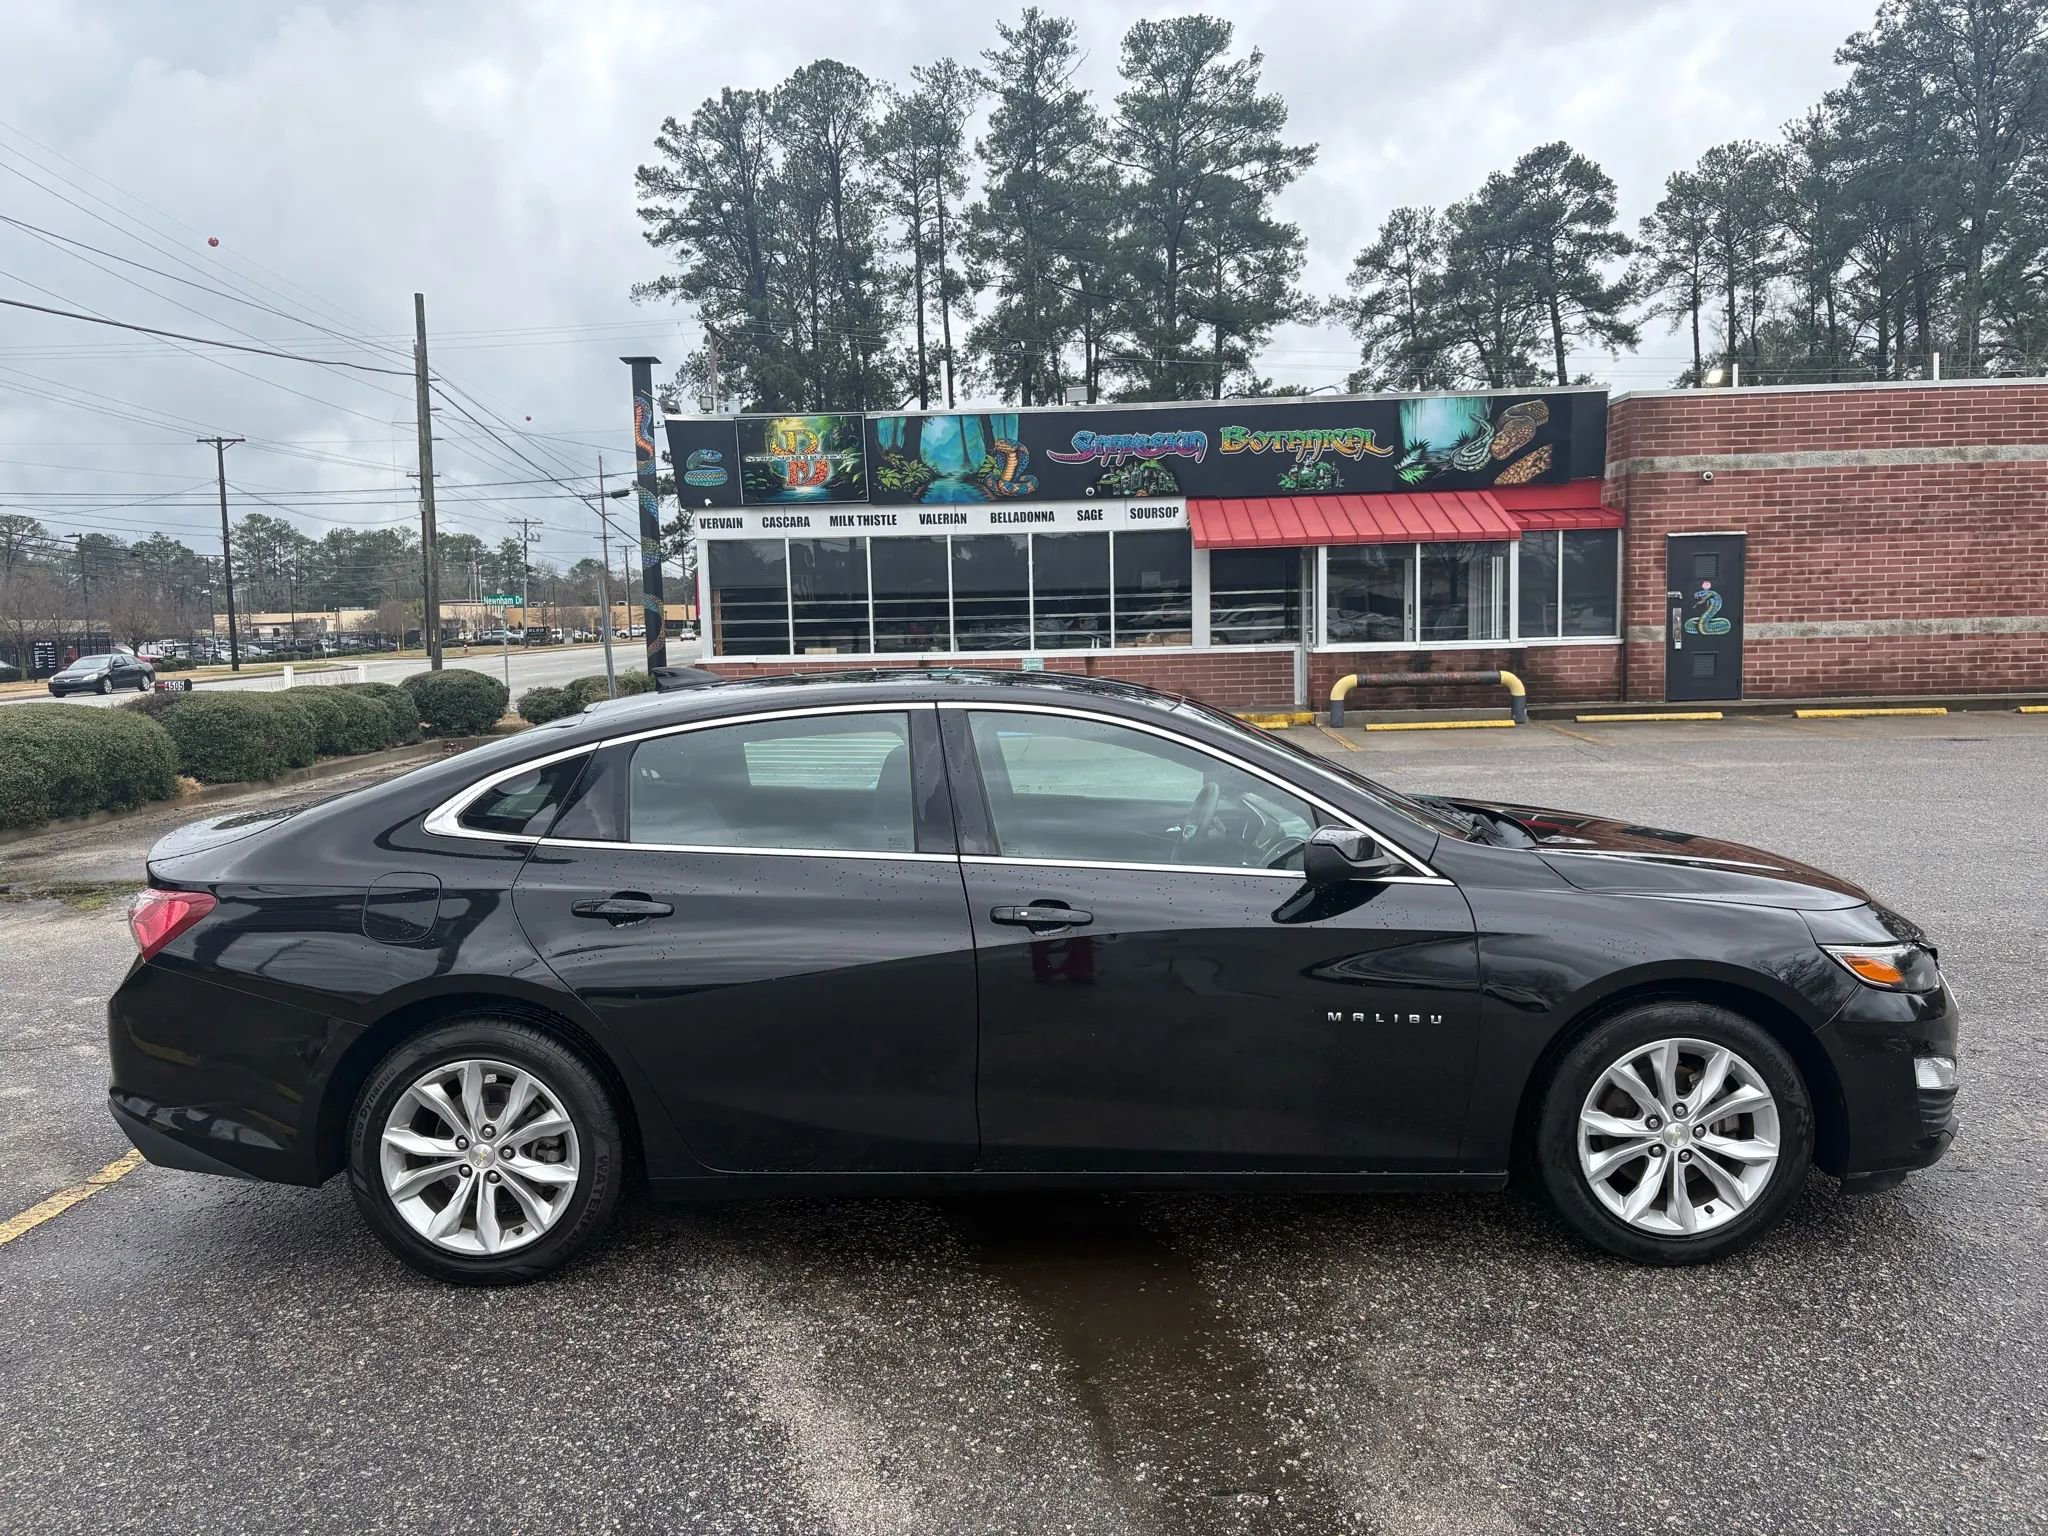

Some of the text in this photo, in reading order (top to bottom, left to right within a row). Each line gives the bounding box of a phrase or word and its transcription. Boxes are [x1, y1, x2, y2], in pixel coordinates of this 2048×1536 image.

[918, 513, 967, 525] VALERIAN
[990, 510, 1055, 524] BELLADONNA
[1076, 509, 1104, 521] SAGE
[1129, 507, 1179, 519] SOURSOP
[699, 517, 743, 530] VERVAIN
[762, 516, 811, 528] CASCARA
[829, 514, 898, 527] MILK THISTLE
[484, 595, 523, 605] Newnham Dr
[1327, 1011, 1442, 1024] MALIBU
